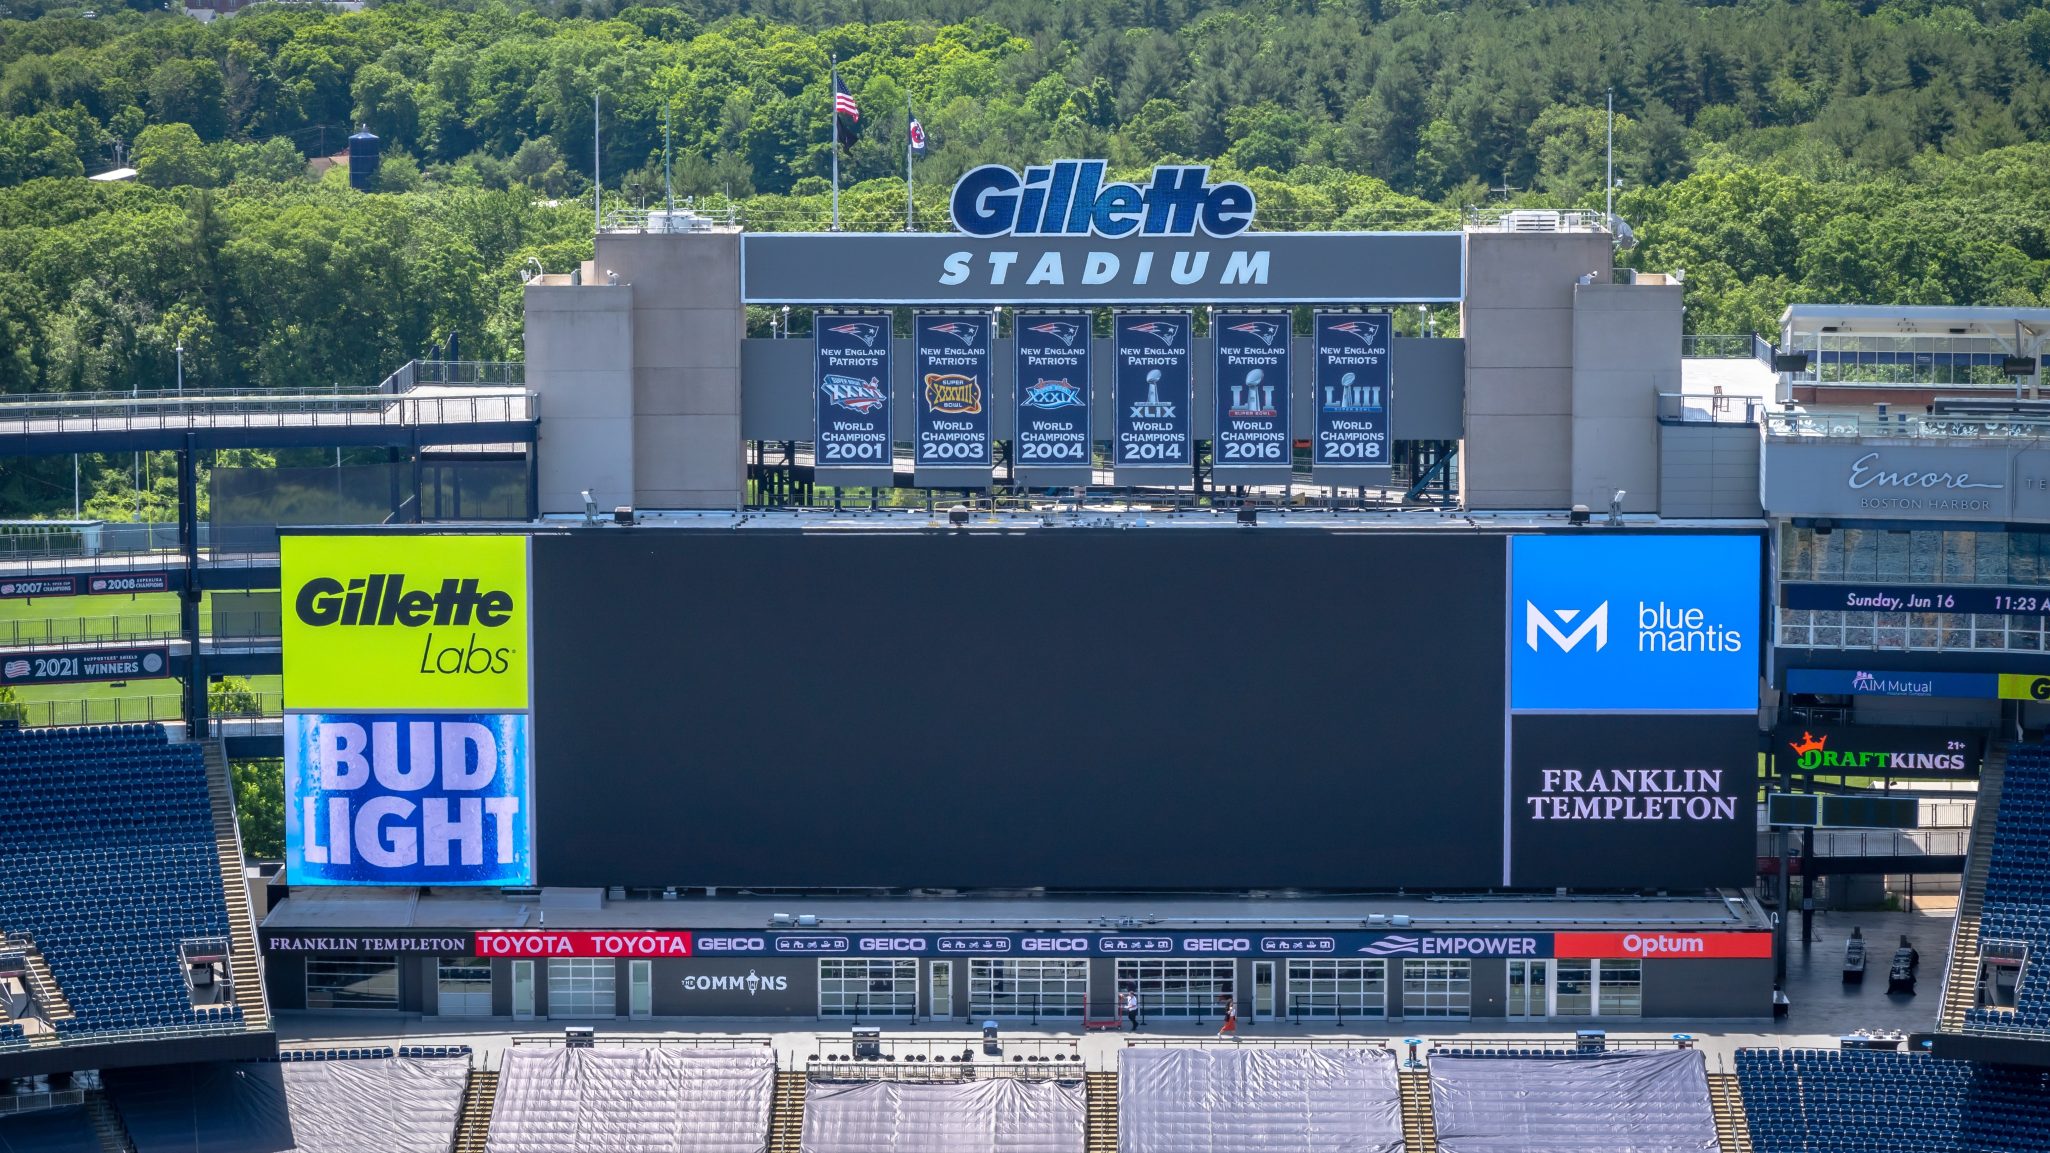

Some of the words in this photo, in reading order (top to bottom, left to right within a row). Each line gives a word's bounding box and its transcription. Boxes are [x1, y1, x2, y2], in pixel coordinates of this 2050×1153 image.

[950, 159, 1256, 239] Gillette
[938, 251, 1271, 286] STADIUM
[829, 357, 878, 366] PATRIOTS
[929, 357, 978, 365] PATRIOTS
[1028, 356, 1078, 365] PATRIOTS
[1128, 356, 1178, 365] PATRIOTS
[1228, 356, 1278, 364] PATRIOTS
[1328, 356, 1378, 364] PATRIOTS
[1230, 386, 1274, 409] LI
[1324, 386, 1380, 407] LIII
[1130, 406, 1176, 418] XLIX
[834, 422, 874, 431] WORLD
[933, 421, 973, 430] WORLD
[1033, 421, 1073, 430] WORLD
[1133, 422, 1173, 431] WORLD
[1233, 421, 1273, 430] WORLD
[1333, 421, 1373, 430] WORLD
[822, 432, 886, 442] CHAMPIONS
[921, 432, 985, 441] CHAMPIONS
[1021, 432, 1085, 441] CHAMPIONS
[1121, 432, 1185, 442] CHAMPIONS
[1221, 432, 1285, 441] CHAMPIONS
[1321, 432, 1385, 441] CHAMPIONS
[825, 443, 882, 458] 2001
[923, 443, 984, 458] 2003
[1022, 443, 1084, 458] 2004
[1125, 443, 1181, 459] 2014
[1225, 443, 1280, 458] 2016
[1324, 443, 1380, 458] 2018
[1848, 452, 2004, 488] Encore
[1861, 498, 1922, 509] BOSTON
[1928, 500, 1991, 510] HARBOR
[16, 583, 42, 593] 2007
[108, 579, 135, 589] 2008
[296, 574, 514, 627] Gillette
[1847, 592, 1903, 610] Sunday,
[1906, 594, 1932, 608] Jun
[1936, 594, 1954, 608] 16
[1995, 596, 2036, 611] 11:23
[1639, 601, 1703, 630] blue
[1639, 624, 1742, 652] mantis
[420, 632, 510, 674] Labs
[35, 658, 78, 677] 2021
[84, 662, 139, 674] WINNERS
[1859, 680, 1885, 691] AIM
[1888, 681, 1932, 692] Mutual
[1948, 741, 1966, 750] 21+
[320, 722, 498, 792] BUD
[1797, 750, 1965, 770] DRAFTKINGS
[1542, 770, 1722, 792] FRANKLIN
[1528, 796, 1738, 820] TEMPLETON
[304, 796, 519, 868] LIGHT
[270, 937, 358, 951] FRANKLIN
[365, 938, 465, 952] TEMPLETON
[478, 936, 574, 954] TOYOTA
[591, 936, 686, 954] TOYOTA
[698, 937, 765, 952] GEICO
[859, 937, 926, 952] GEICO
[1021, 937, 1088, 952] GEICO
[1183, 937, 1250, 951] GEICO
[1422, 937, 1536, 955] EMPOWER
[1623, 934, 1704, 957] Optum
